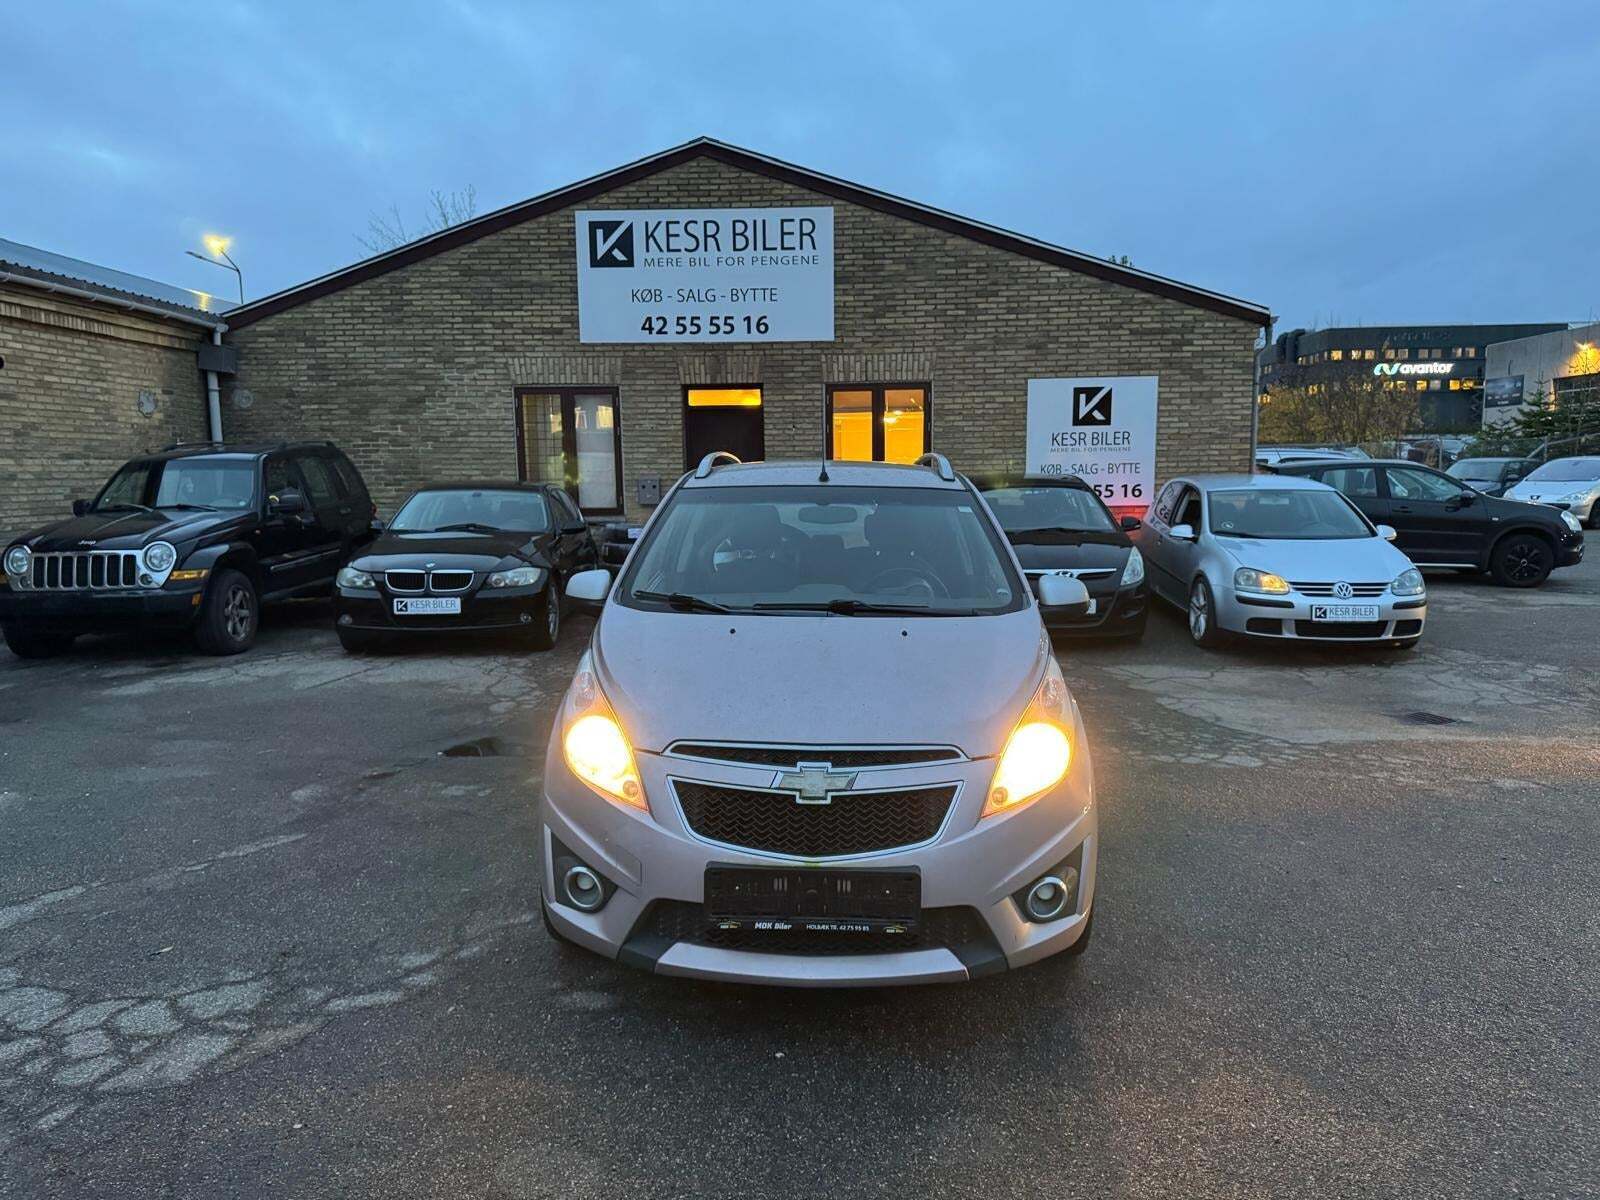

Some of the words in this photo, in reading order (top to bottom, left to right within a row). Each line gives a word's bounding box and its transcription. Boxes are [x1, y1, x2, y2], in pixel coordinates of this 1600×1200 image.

[644, 219, 721, 254] KESR
[732, 218, 817, 251] BILER
[644, 256, 683, 268] MERE
[689, 256, 710, 267] BIL
[717, 255, 745, 267] FOR
[752, 254, 819, 266] PENGENE
[631, 288, 663, 303] KØB
[676, 288, 716, 303] SALG
[730, 287, 779, 302] BYTTE
[640, 315, 669, 335] 42
[675, 316, 702, 335] 55
[708, 315, 735, 334] 55
[742, 315, 769, 334] 16
[1400, 362, 1455, 374] avantor
[1051, 431, 1087, 447] KESR
[1091, 430, 1131, 446] BILER
[1040, 463, 1062, 475] KØB
[1071, 463, 1098, 475] SALG
[1107, 462, 1141, 474] BYTTE
[1121, 483, 1142, 498] 16
[409, 600, 430, 609] KESR
[432, 599, 456, 609] BILER
[1329, 607, 1350, 616] KESR
[1351, 607, 1374, 616] BILER
